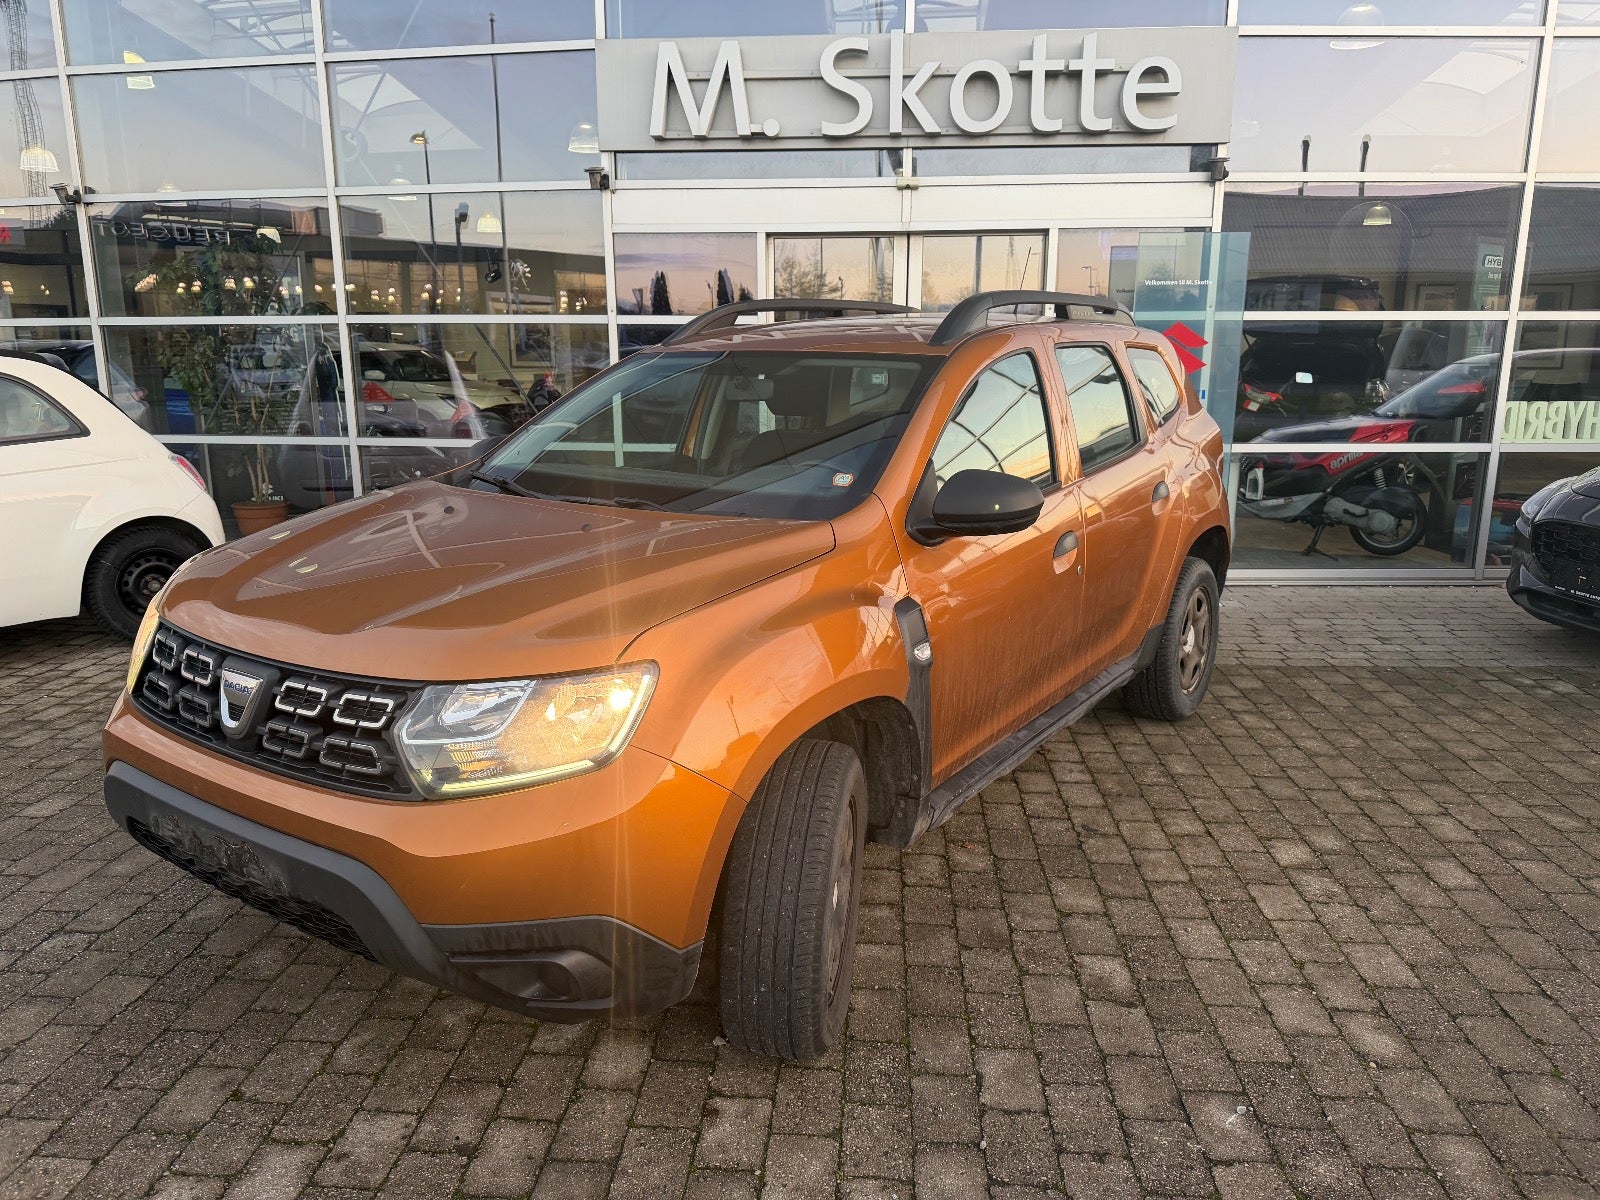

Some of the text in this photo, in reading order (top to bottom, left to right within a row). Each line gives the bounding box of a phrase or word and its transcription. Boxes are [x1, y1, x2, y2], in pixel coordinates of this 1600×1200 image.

[650, 29, 1182, 141] M. Skotte
[224, 679, 250, 694] DACIA
